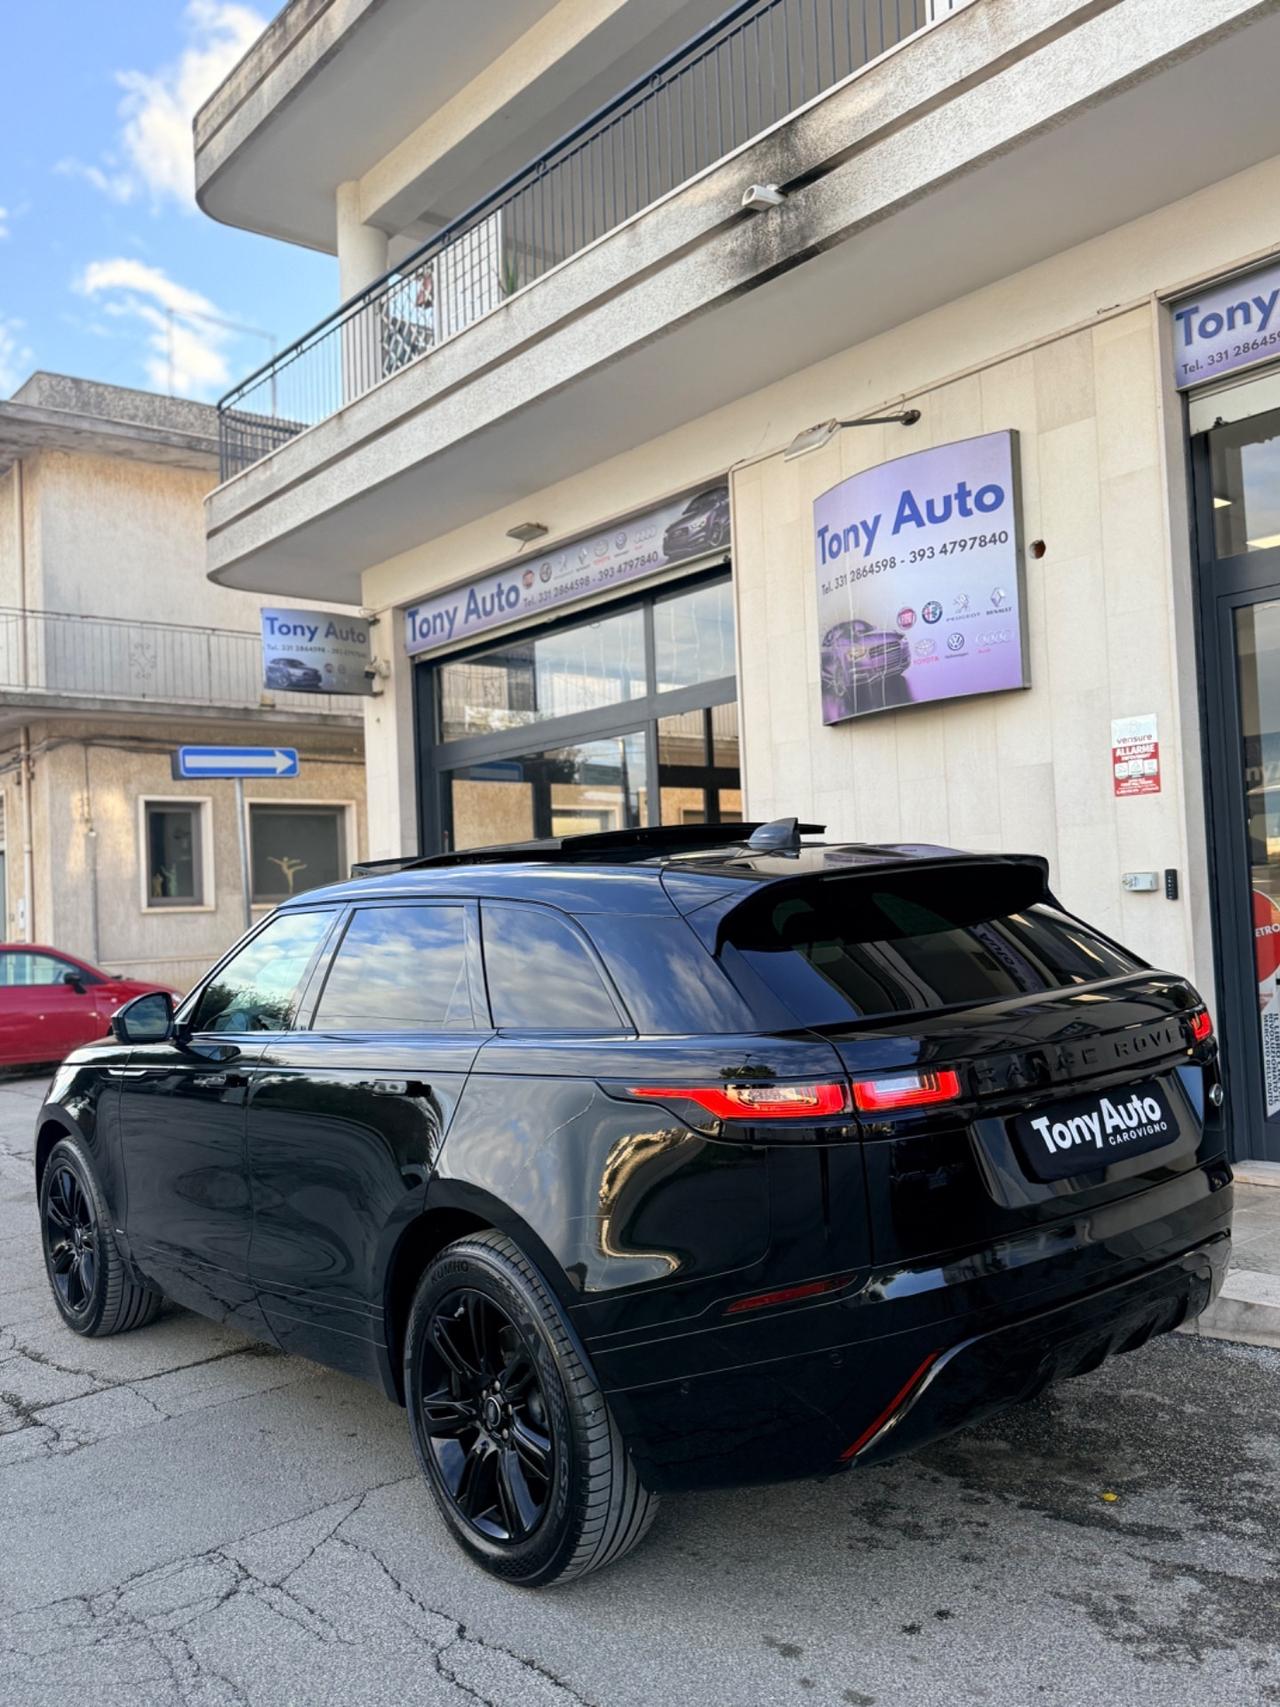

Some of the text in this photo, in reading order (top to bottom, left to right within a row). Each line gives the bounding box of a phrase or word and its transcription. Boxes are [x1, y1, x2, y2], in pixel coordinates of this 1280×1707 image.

[1175, 289, 1280, 347] Tony
[1181, 359, 1204, 375] Tel.
[1207, 350, 1229, 366] 331
[817, 481, 1005, 566] Tony Auto
[553, 575, 590, 598] 2864598
[598, 566, 615, 582] 393
[616, 550, 659, 574] 4797840
[821, 580, 833, 596] Tel.
[834, 574, 848, 590] 331
[849, 556, 897, 583] 2864598
[909, 546, 936, 564] 393
[938, 530, 1009, 556] 4797840
[265, 616, 367, 644] Tony Auto
[407, 582, 520, 642] Tony Auto
[1108, 1121, 1168, 1146] CAROVIGNO
